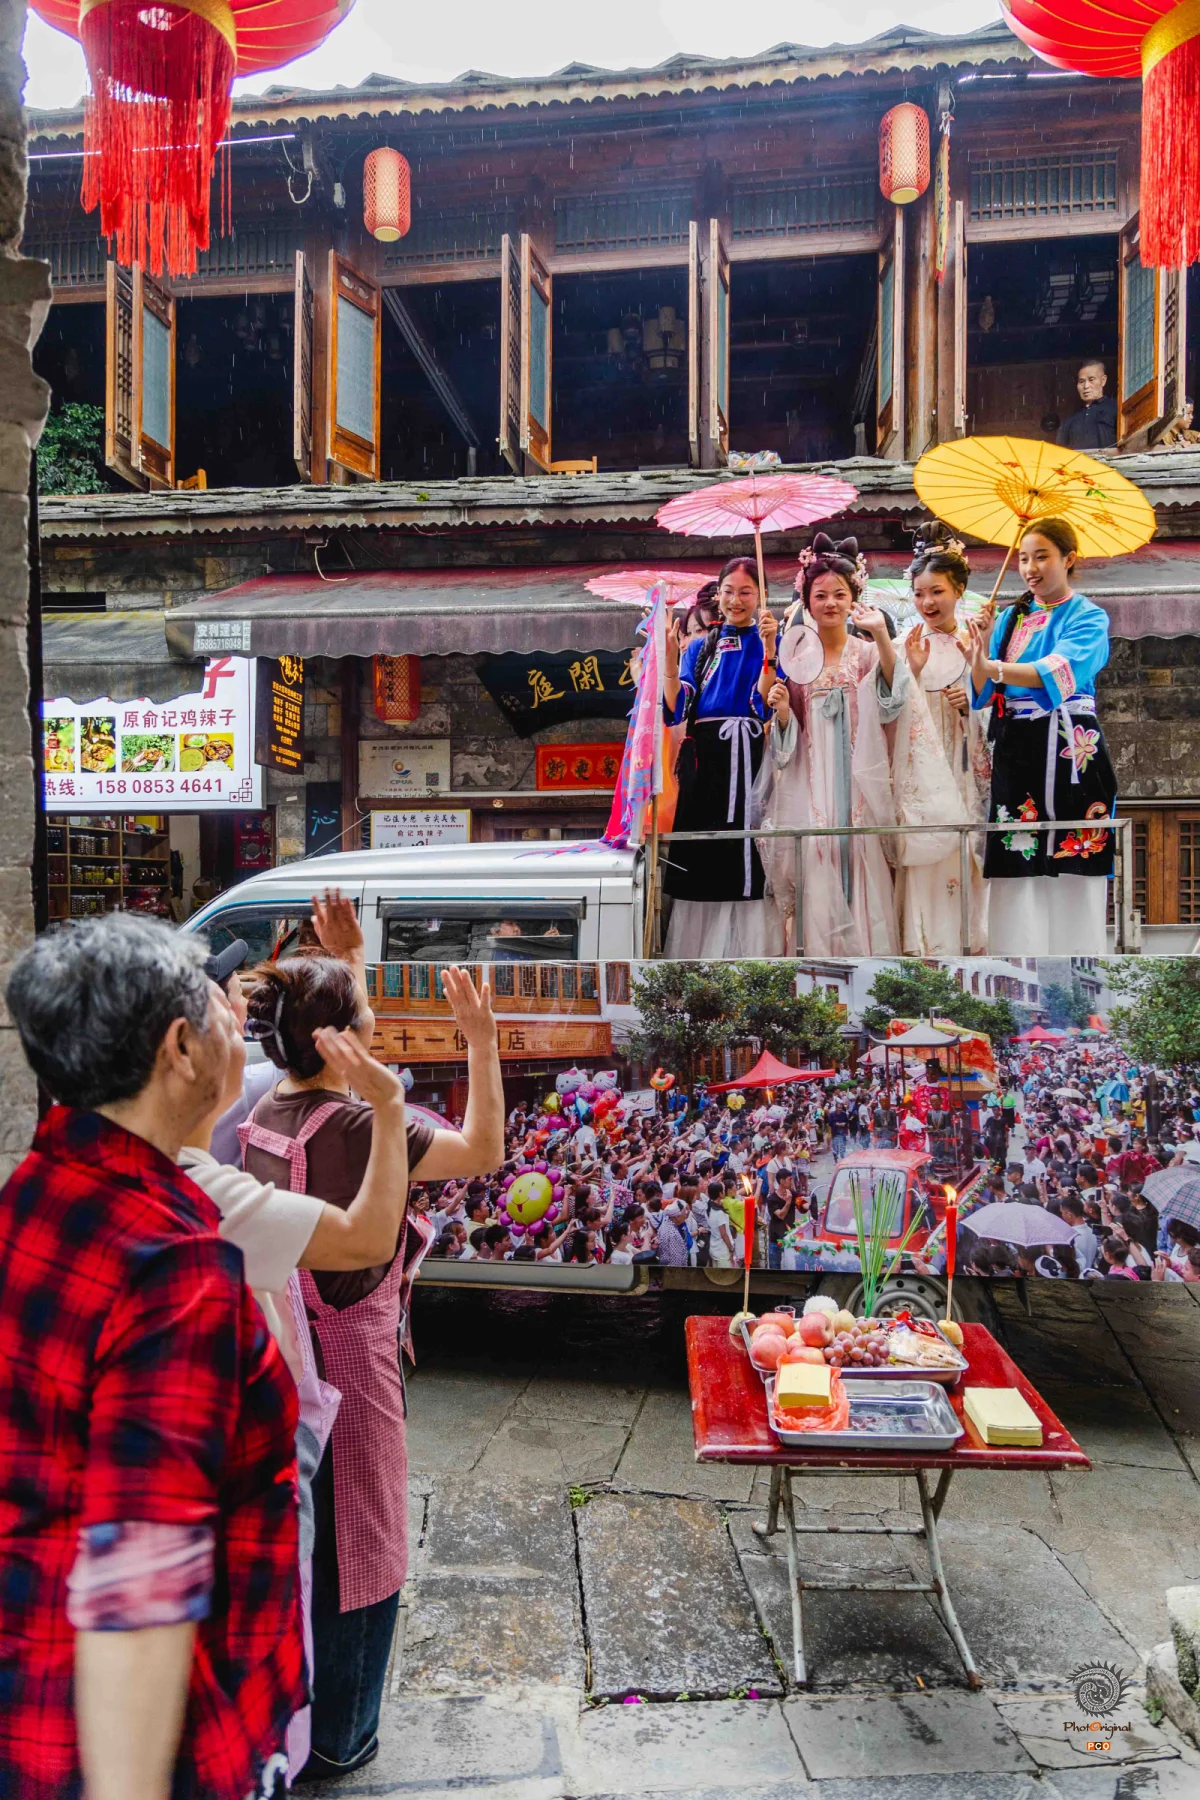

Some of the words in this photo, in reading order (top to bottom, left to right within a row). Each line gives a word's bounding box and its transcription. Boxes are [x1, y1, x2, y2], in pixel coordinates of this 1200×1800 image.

[123, 709, 236, 728] 原俞记鸡辣子
[96, 780, 127, 794] 158
[132, 780, 175, 793] 0853
[180, 778, 222, 792] 4641
